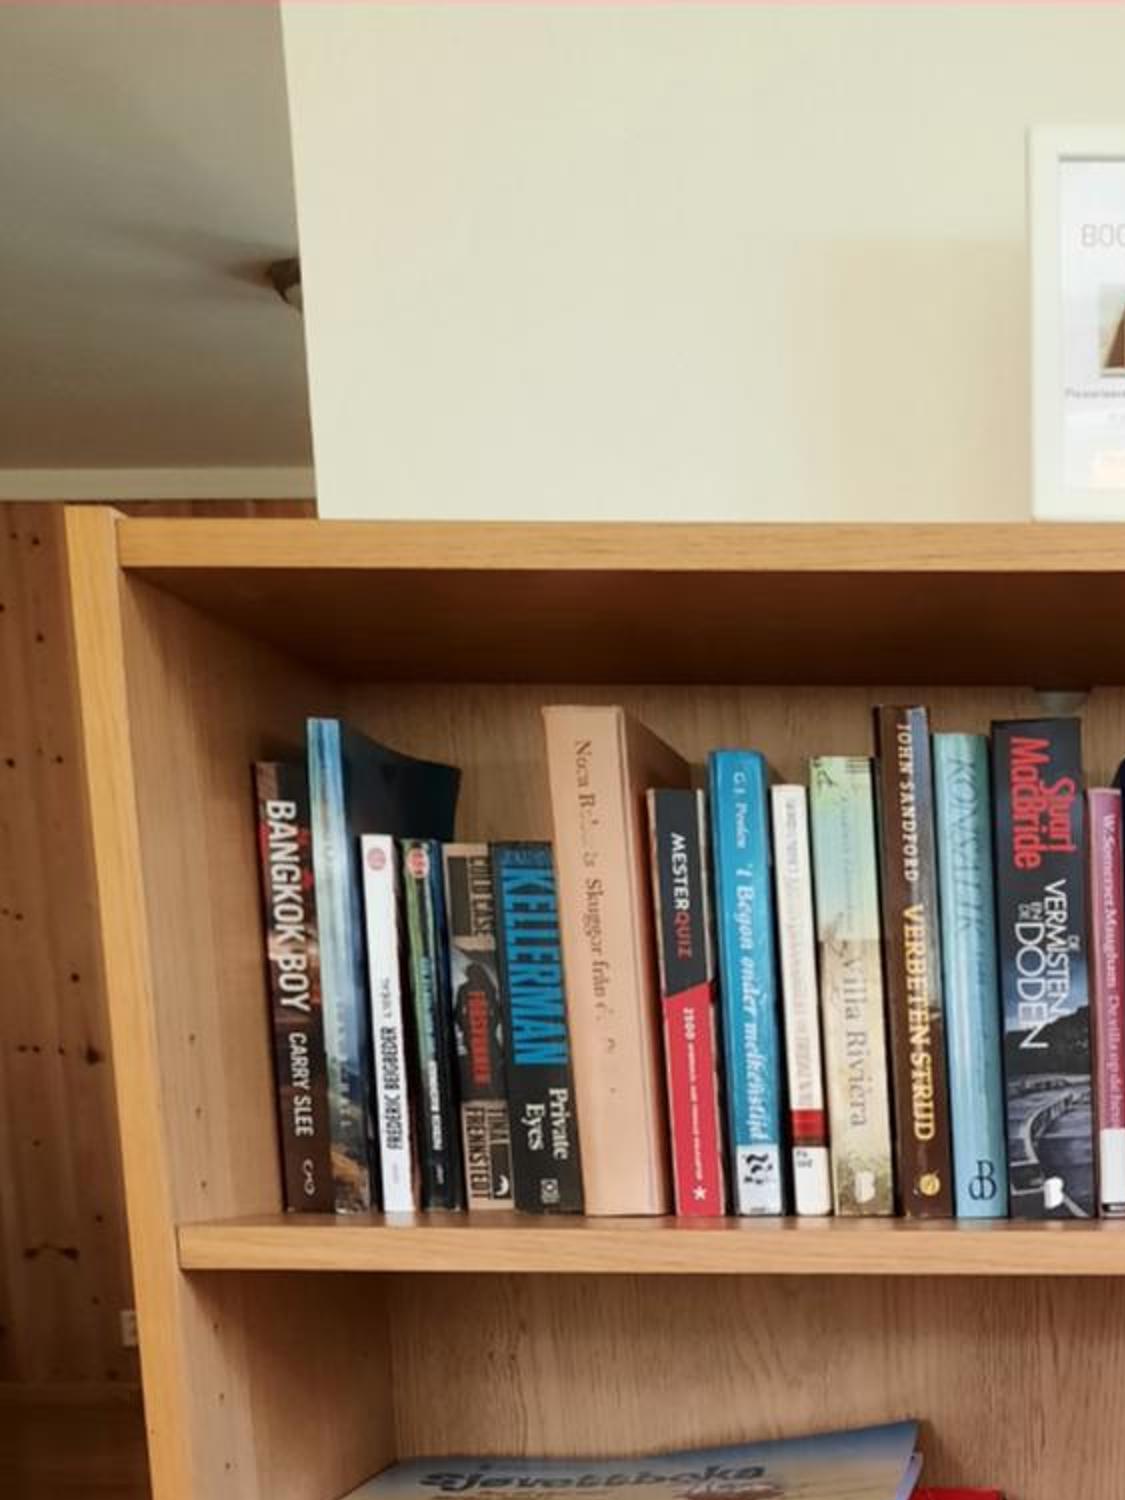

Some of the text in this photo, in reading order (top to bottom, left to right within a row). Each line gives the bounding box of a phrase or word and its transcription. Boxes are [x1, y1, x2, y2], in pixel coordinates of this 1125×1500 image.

[897, 725, 919, 881] JOHN SANDFORD
[1010, 737, 1049, 869] MacBride
[1039, 777, 1076, 851] Stuart
[266, 801, 310, 1013] BANGKOK BOY
[670, 833, 692, 958] MESTERQUIZ
[1030, 902, 1042, 919] EN
[1043, 879, 1071, 1017] VERMISTEN
[1067, 935, 1080, 949] DE
[1101, 909, 1118, 988] Maugham
[502, 869, 569, 1065] KELLERMAN
[904, 904, 935, 1141] VERBETEN STRIJD
[1015, 922, 1048, 1049] DODEN
[289, 1033, 313, 1136] CARRY SLEE
[521, 1104, 548, 1150] Eyes
[549, 1088, 571, 1159] Private
